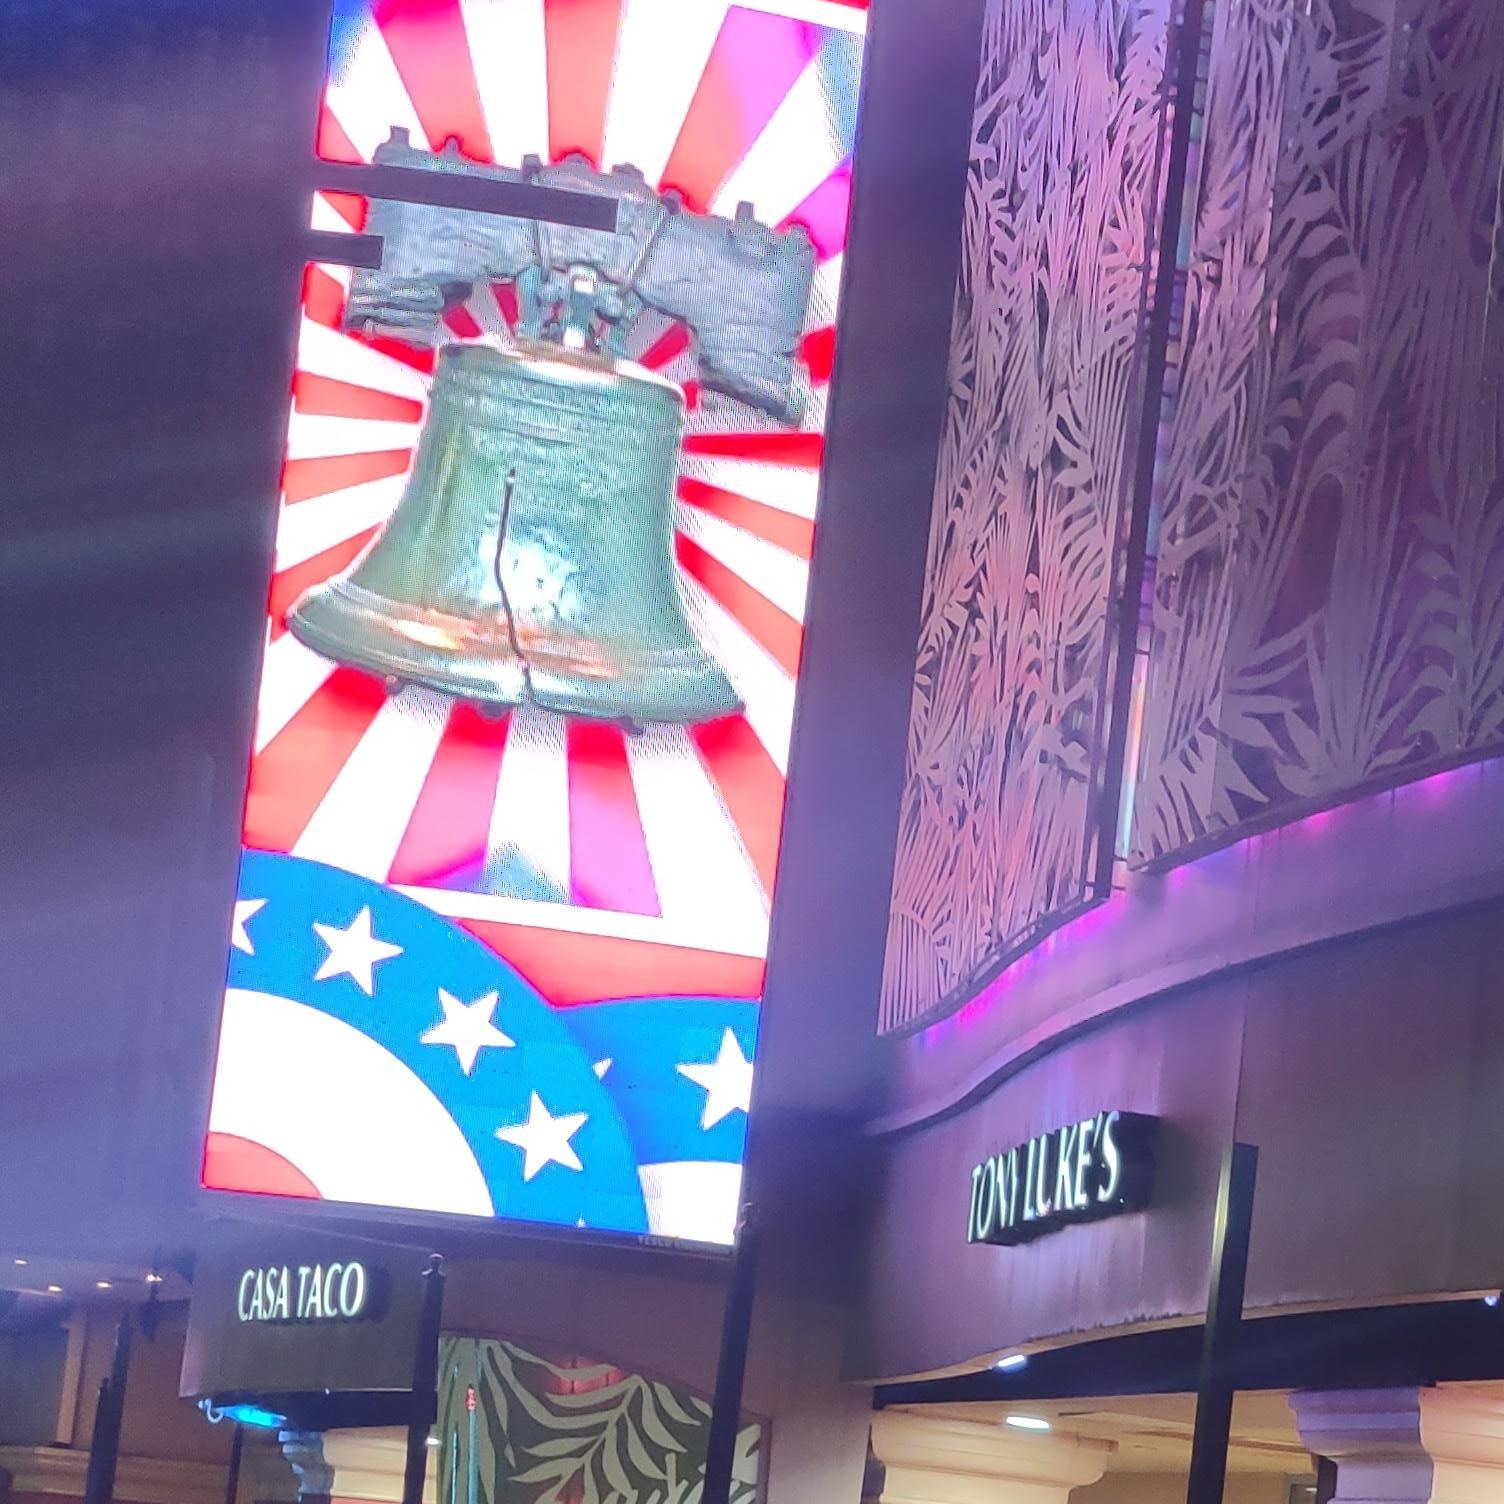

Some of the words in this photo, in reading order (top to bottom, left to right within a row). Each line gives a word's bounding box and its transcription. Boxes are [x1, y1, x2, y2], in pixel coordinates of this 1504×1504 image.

[967, 1147, 1020, 1243] TONY
[1022, 1110, 1123, 1221] LUKE'S
[237, 1265, 290, 1322] CASA
[296, 1262, 366, 1319] TACO
